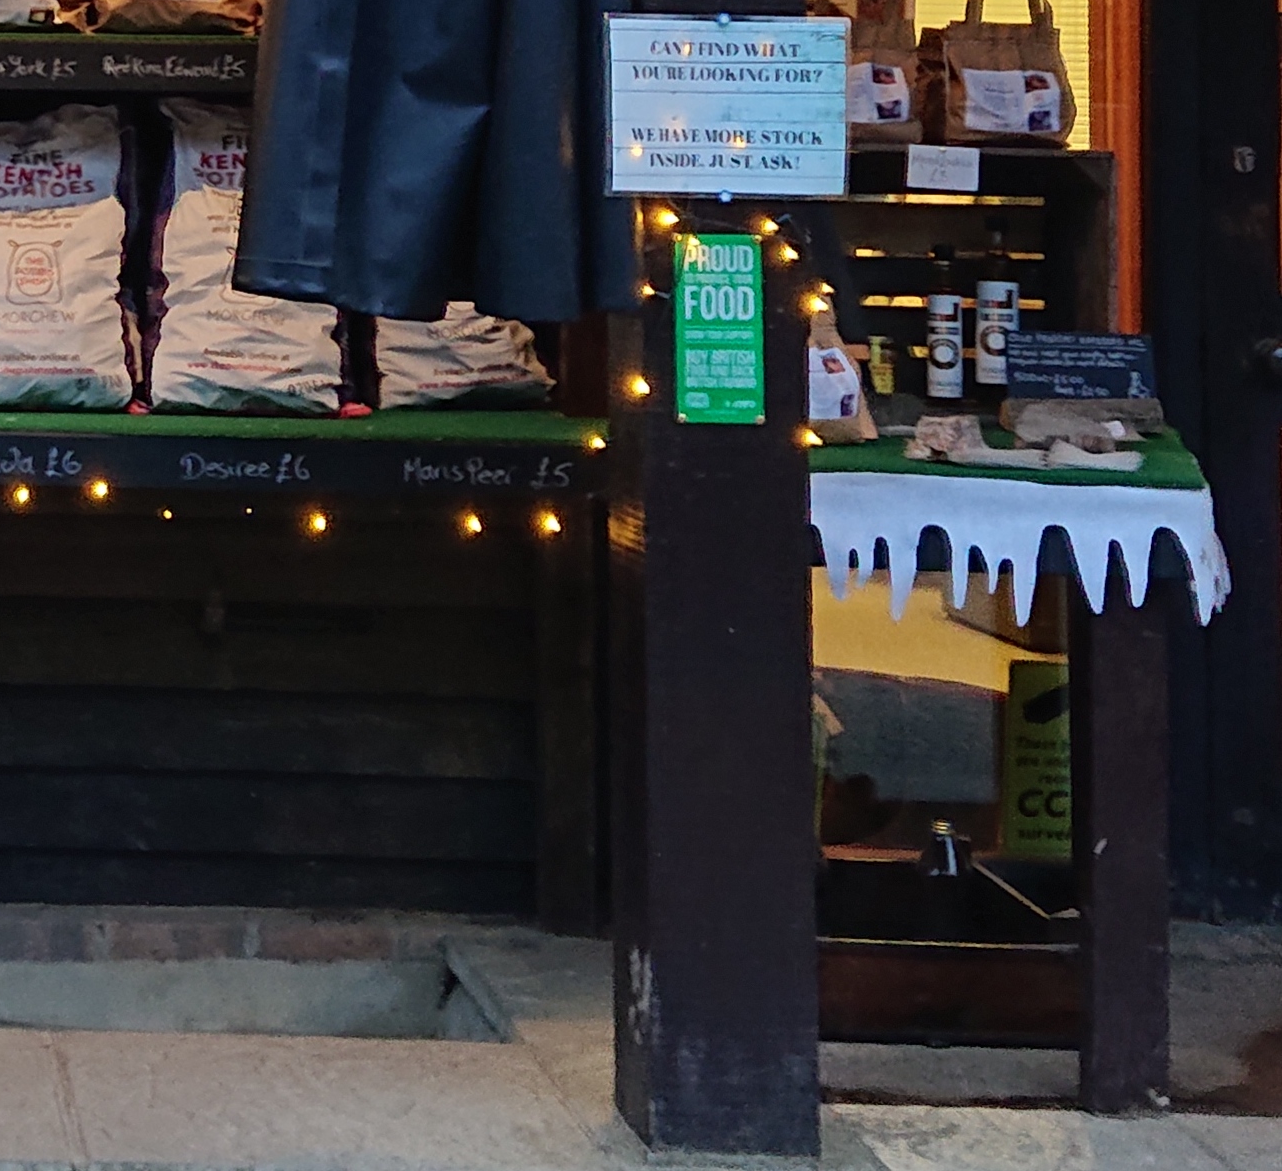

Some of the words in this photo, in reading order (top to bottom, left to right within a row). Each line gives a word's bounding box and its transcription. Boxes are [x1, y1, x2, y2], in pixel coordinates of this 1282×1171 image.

[698, 41, 740, 59] FIND
[742, 42, 802, 59] WHAT
[689, 66, 771, 84] LOOKING
[773, 67, 824, 85] FOR?
[630, 127, 655, 143] WE
[658, 127, 700, 144] HAVE
[703, 128, 756, 146] MORE
[760, 129, 824, 146] STOCK
[759, 154, 803, 171] ASK!
[684, 244, 755, 273] PROUD
[684, 285, 756, 321] FOOD
[44, 445, 84, 479] £6
[179, 450, 272, 482] Desiree
[273, 452, 312, 485] £6
[529, 455, 574, 489] £5
